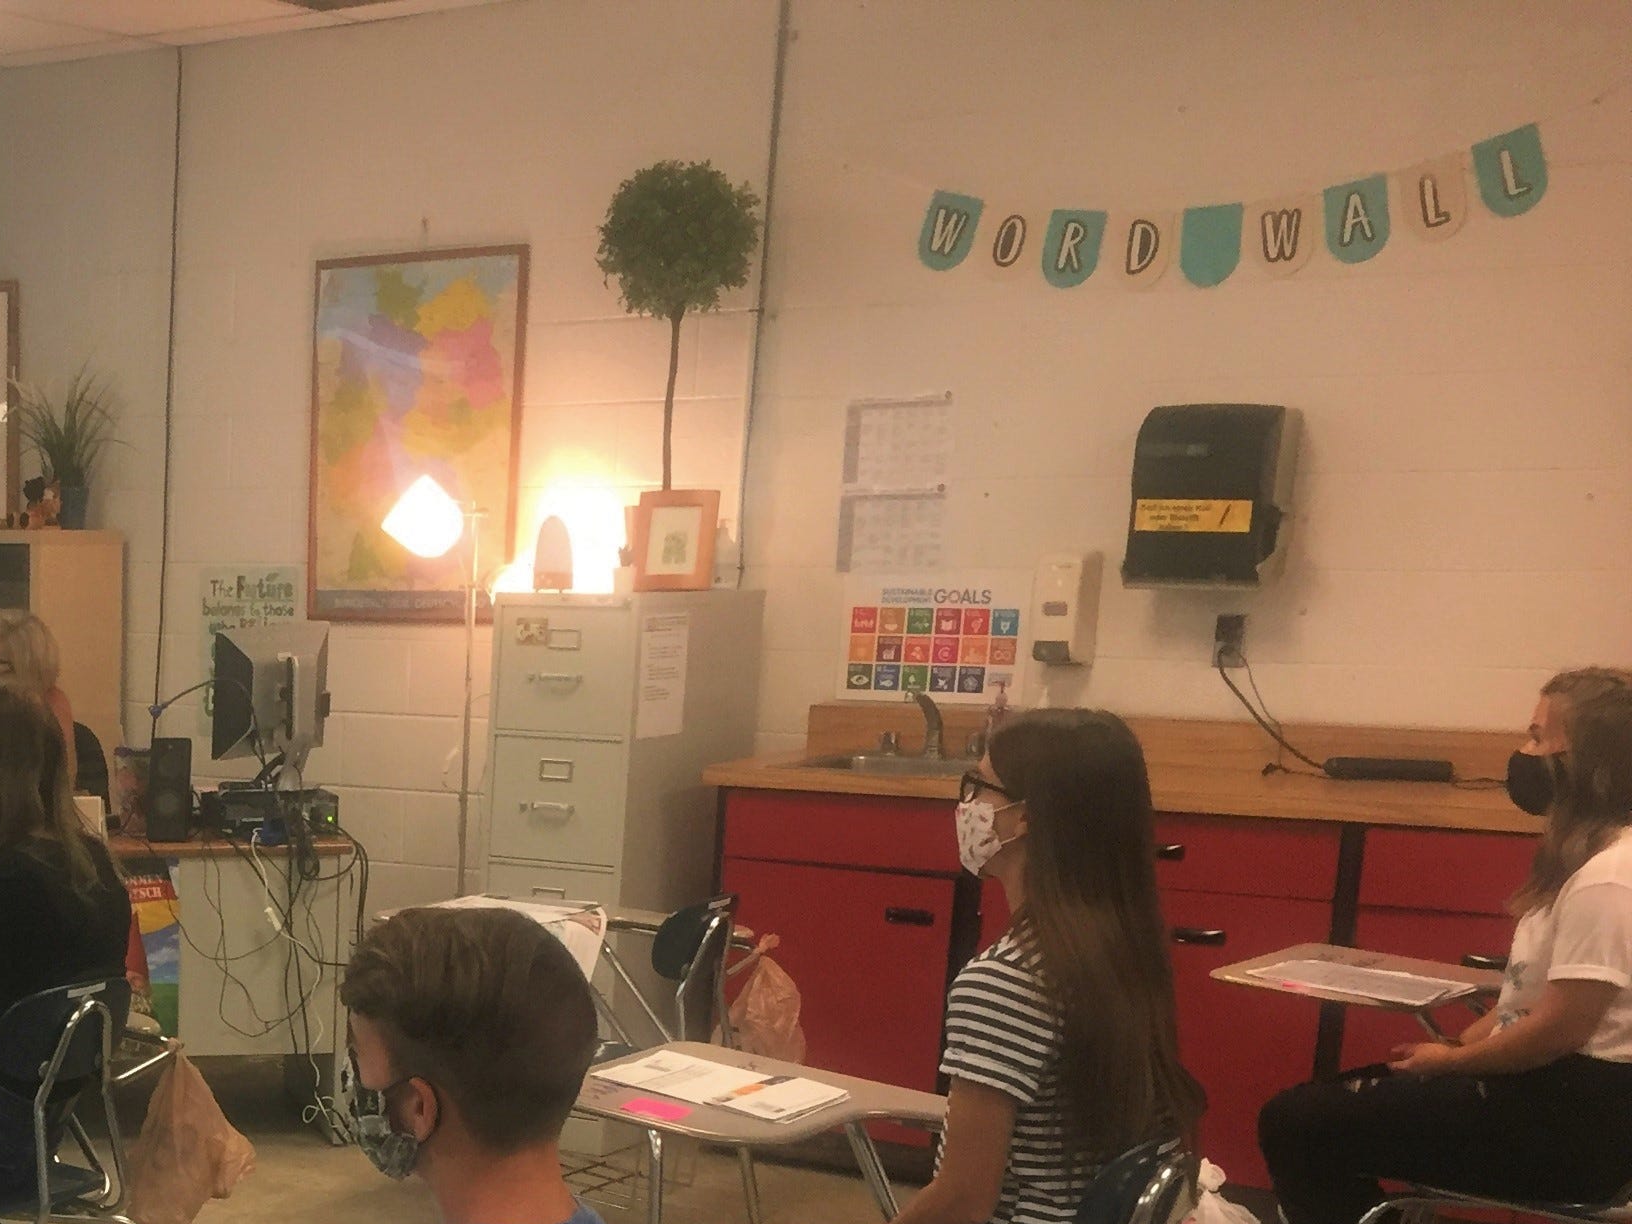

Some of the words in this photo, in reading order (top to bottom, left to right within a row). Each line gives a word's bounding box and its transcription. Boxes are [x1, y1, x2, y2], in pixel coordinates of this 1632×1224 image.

[926, 207, 1160, 275] WORD
[1261, 148, 1532, 262] WALL
[209, 578, 234, 598] The
[933, 587, 993, 605] GOALS
[263, 600, 295, 617] those
